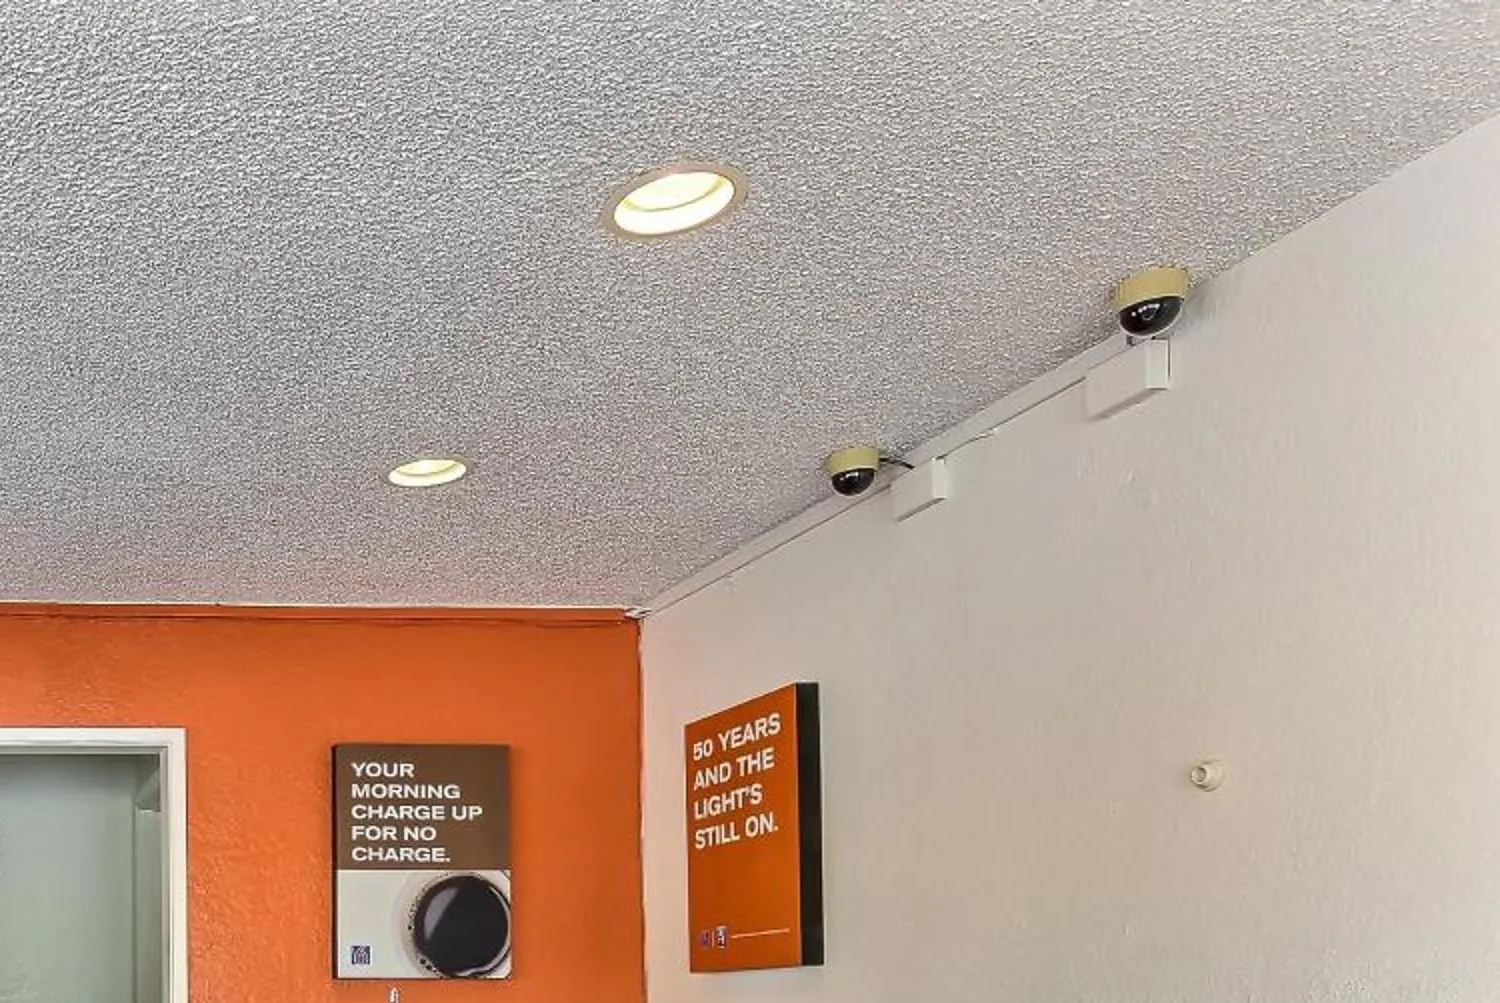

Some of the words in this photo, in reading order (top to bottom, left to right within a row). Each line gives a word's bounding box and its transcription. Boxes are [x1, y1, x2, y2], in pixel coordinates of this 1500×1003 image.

[693, 739, 713, 761] 50
[718, 712, 781, 752] YEARS
[351, 762, 415, 778] YOUR
[693, 763, 732, 790] AND
[736, 747, 775, 777] THE
[351, 783, 461, 799] MORNING
[351, 805, 445, 820] CHARGE
[451, 805, 483, 821] UP
[352, 826, 398, 841] FOR
[403, 826, 437, 841] NO
[695, 821, 740, 850] STILL
[745, 812, 779, 838] ON.
[351, 847, 451, 862] CHARGE.
